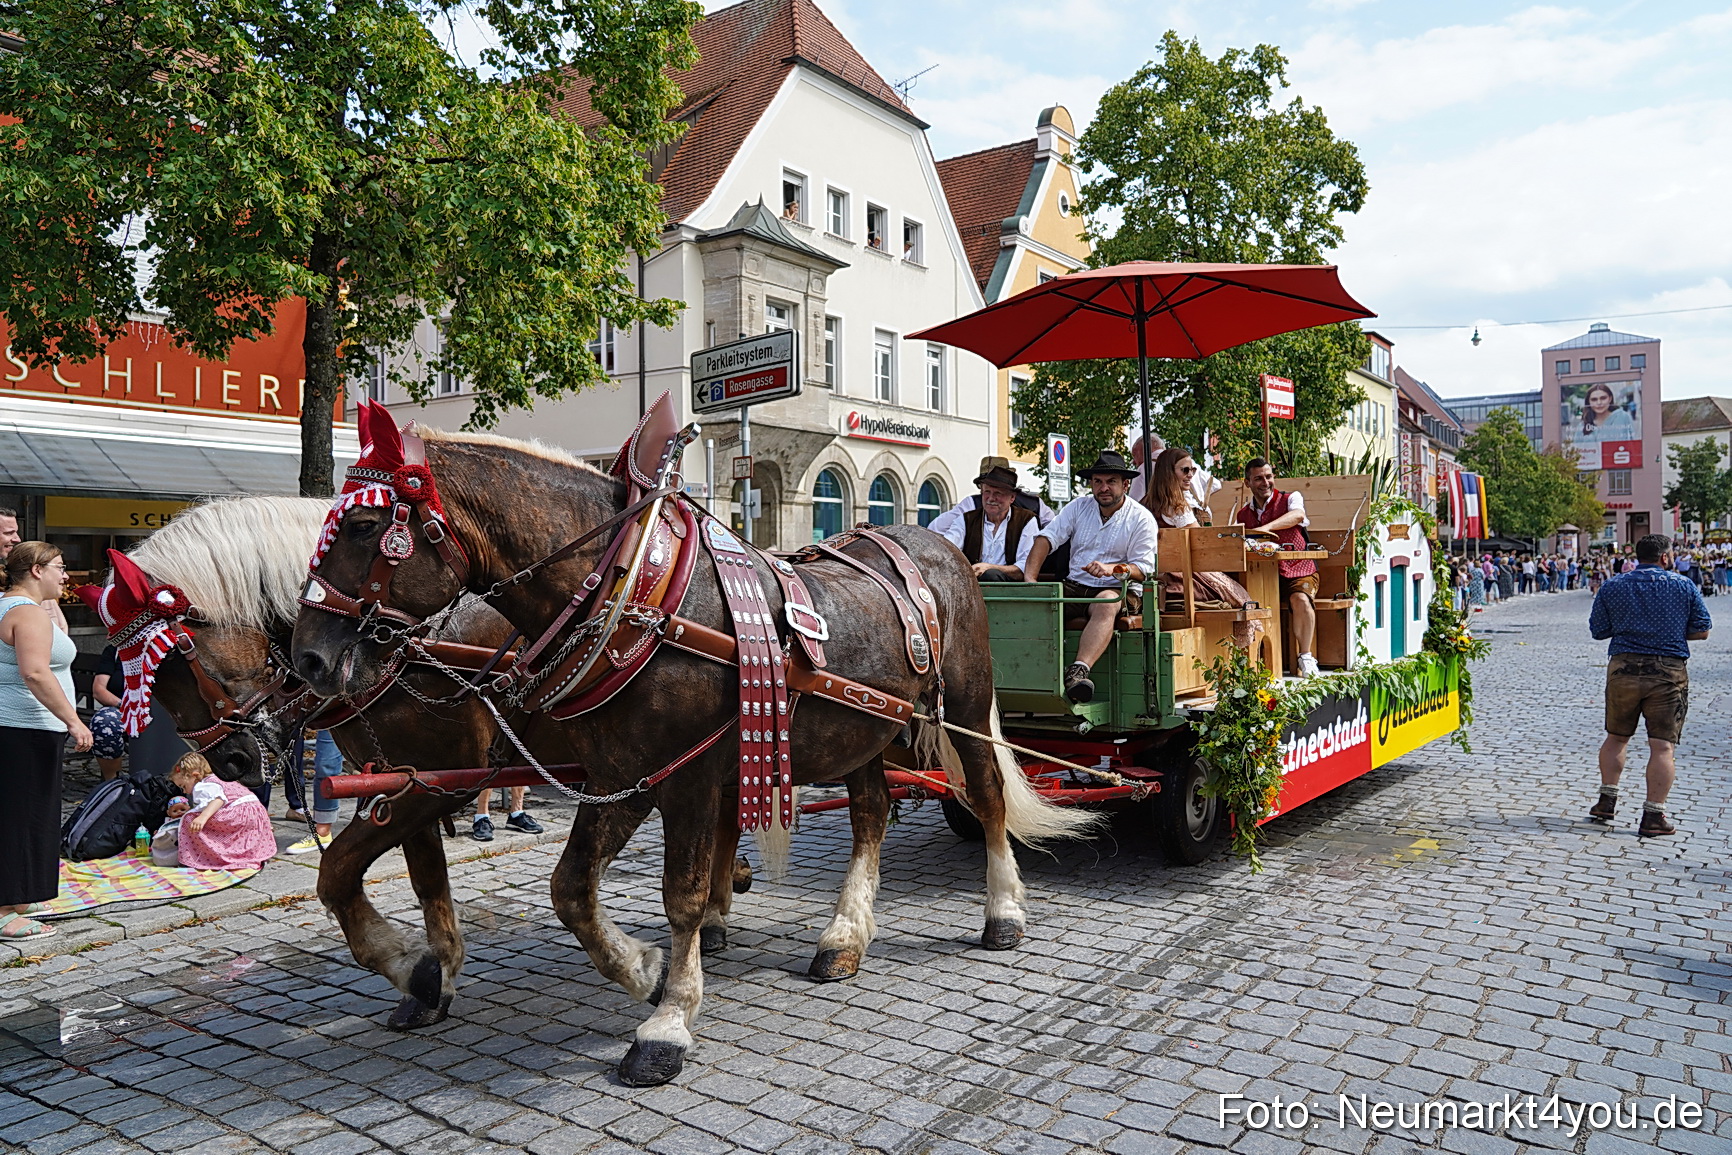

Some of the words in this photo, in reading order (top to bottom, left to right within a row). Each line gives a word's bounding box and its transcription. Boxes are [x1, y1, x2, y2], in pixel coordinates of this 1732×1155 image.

[706, 345, 773, 373] Parkleitsystem
[4, 343, 305, 412] SCHLIER
[729, 374, 774, 394] Rosengasse
[860, 413, 931, 440] HypoVereinsbank
[718, 433, 740, 447] Rosengass
[129, 511, 173, 527] SCH
